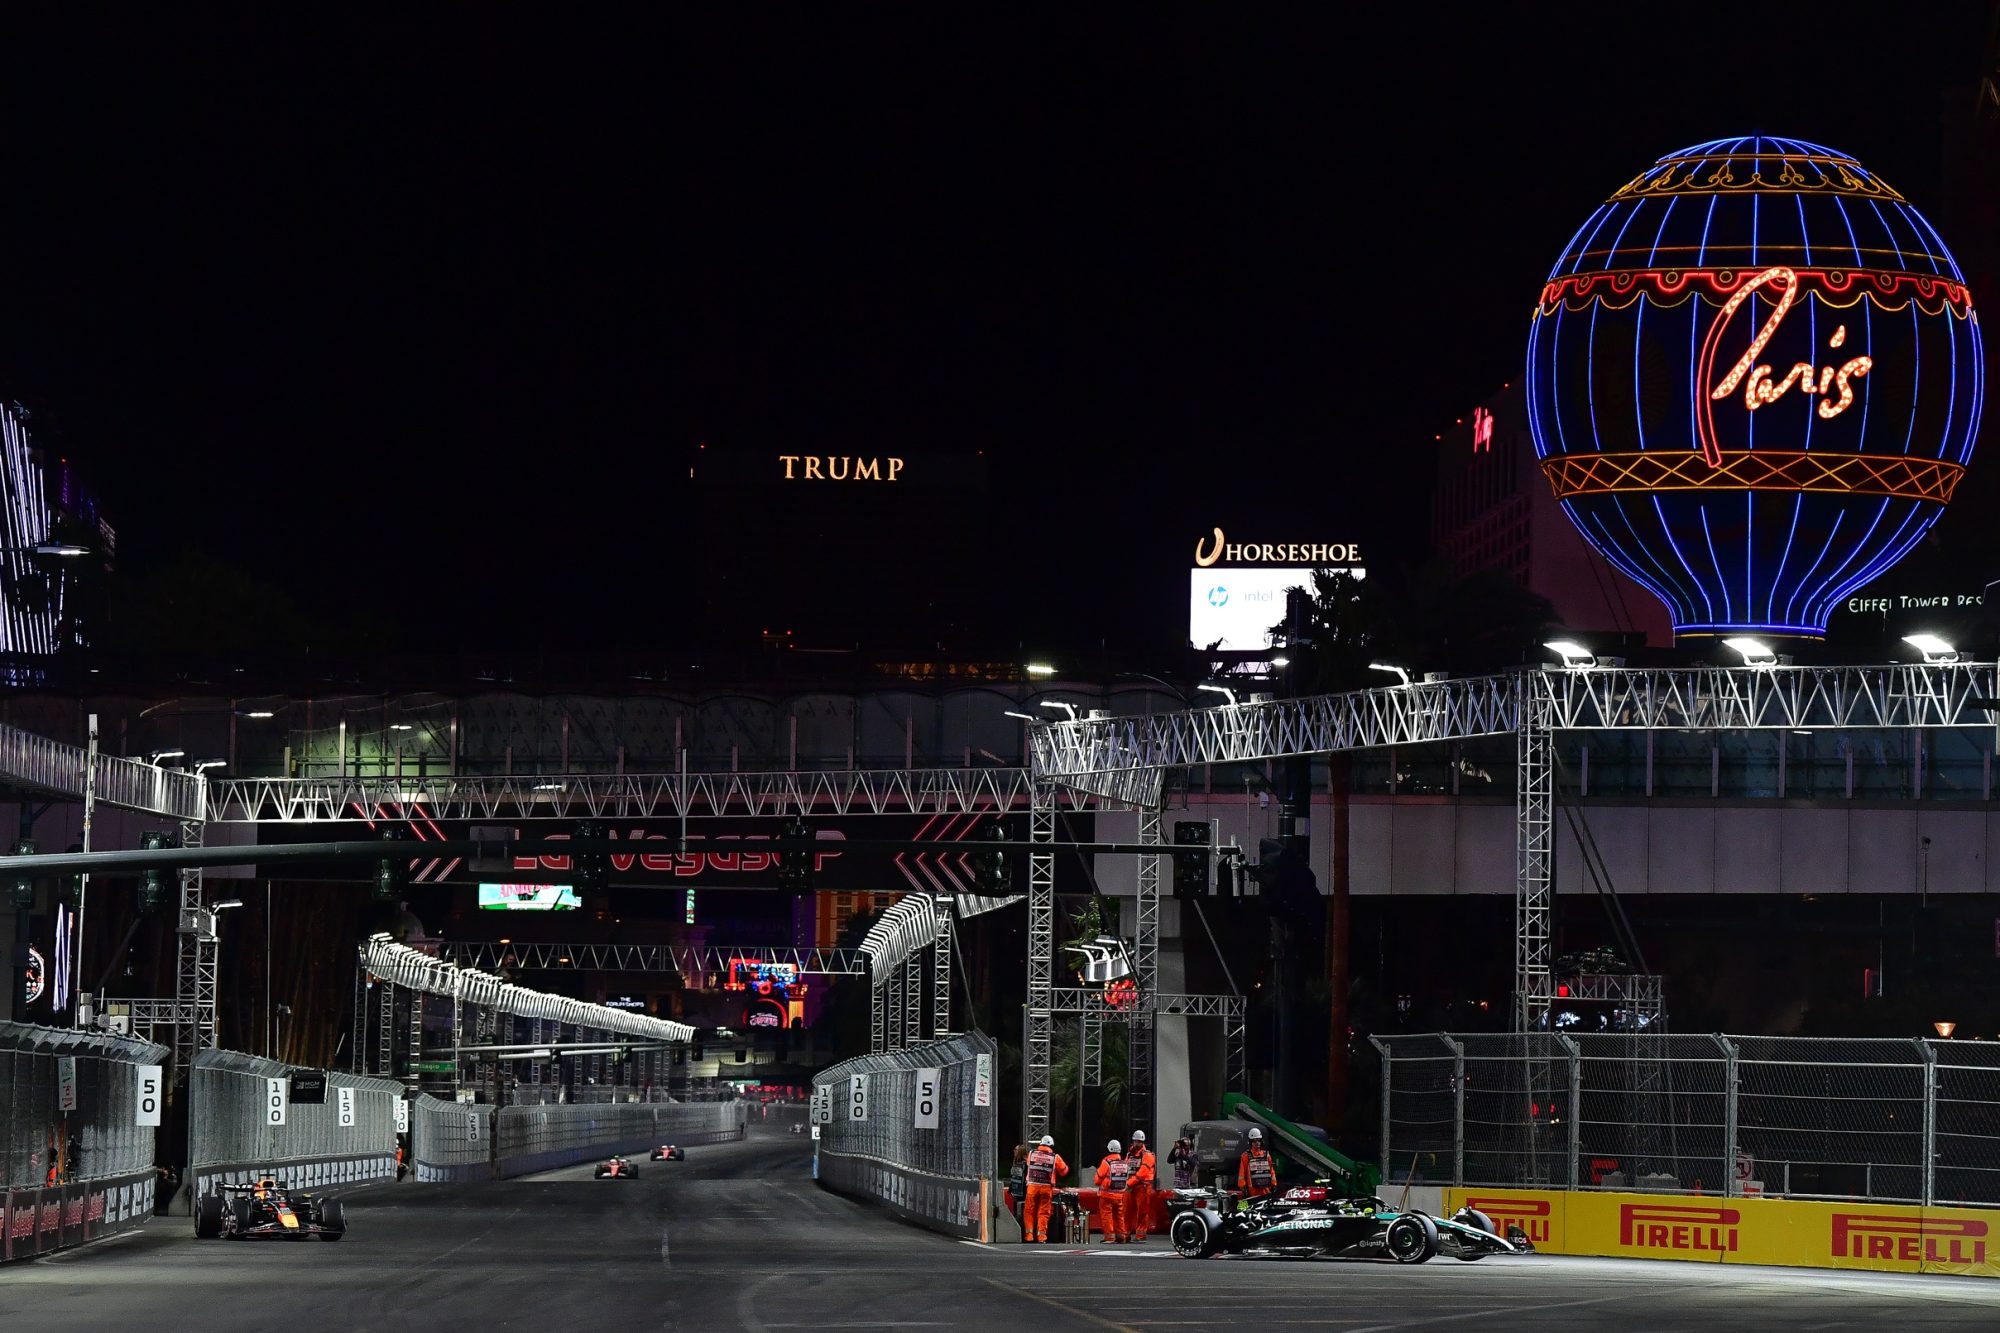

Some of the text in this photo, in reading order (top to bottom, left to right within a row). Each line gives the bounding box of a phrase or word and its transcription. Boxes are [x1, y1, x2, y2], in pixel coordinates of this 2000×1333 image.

[1697, 267, 1872, 467] Paris
[779, 456, 903, 481] TRUMP
[514, 829, 574, 870] La
[142, 1079, 155, 1114] 50
[272, 1081, 282, 1122] 100
[342, 1090, 351, 1125] 150
[821, 1088, 829, 1121] 150
[853, 1077, 864, 1118] 100
[920, 1081, 933, 1116] 50
[1278, 1219, 1334, 1230] PETRONAS
[1438, 1233, 1453, 1241] IWC
[1466, 1197, 1551, 1242] PRELI
[1620, 1203, 1741, 1252] PIRELLI
[1831, 1213, 1989, 1265] PIRELLI
